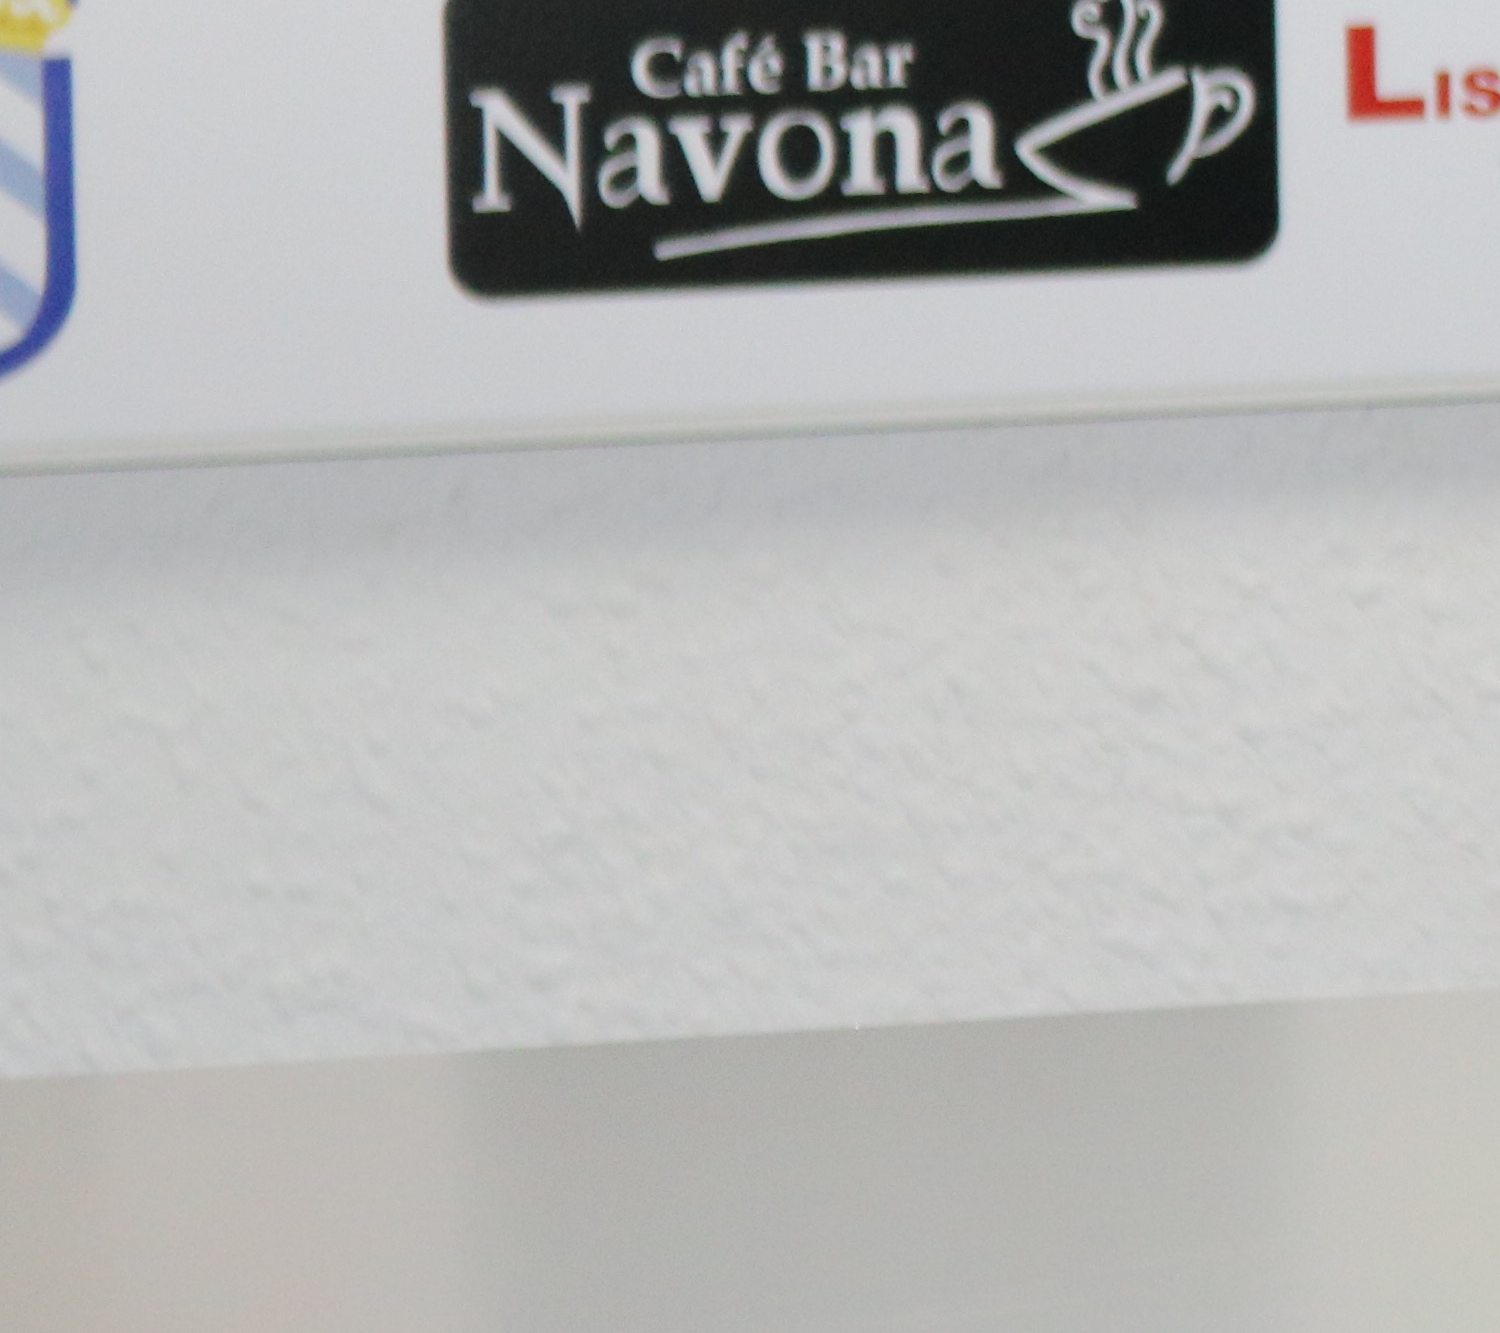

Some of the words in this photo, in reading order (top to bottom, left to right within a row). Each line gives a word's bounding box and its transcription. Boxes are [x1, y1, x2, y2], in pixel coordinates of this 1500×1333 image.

[630, 31, 788, 99] Café
[804, 31, 916, 93] Bar
[468, 83, 1004, 231] Navona
